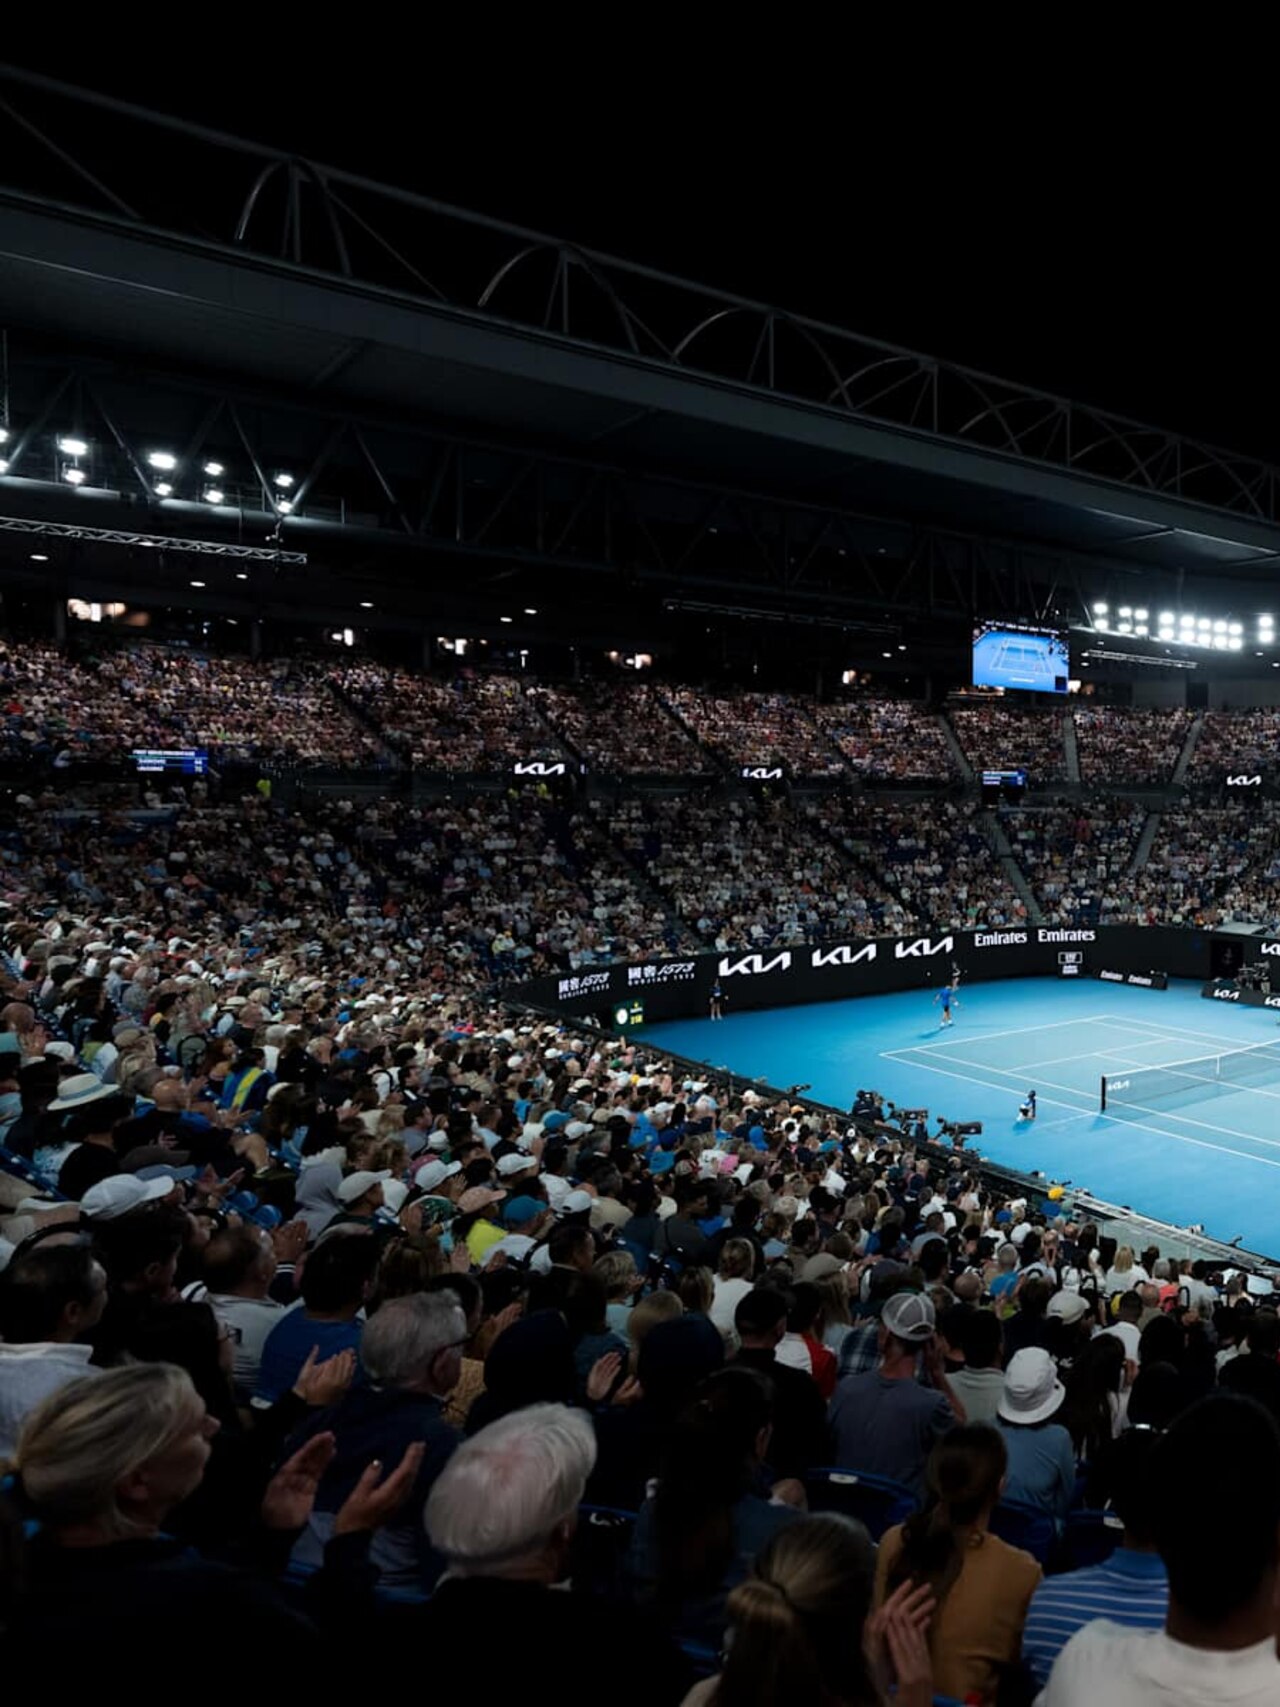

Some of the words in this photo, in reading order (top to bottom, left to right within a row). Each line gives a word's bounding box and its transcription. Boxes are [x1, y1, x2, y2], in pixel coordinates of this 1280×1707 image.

[974, 931, 1028, 947] Emirates
[1037, 928, 1096, 943] Emirates
[812, 943, 877, 967] KIA
[895, 936, 954, 959] KIA
[718, 951, 791, 977] KIA
